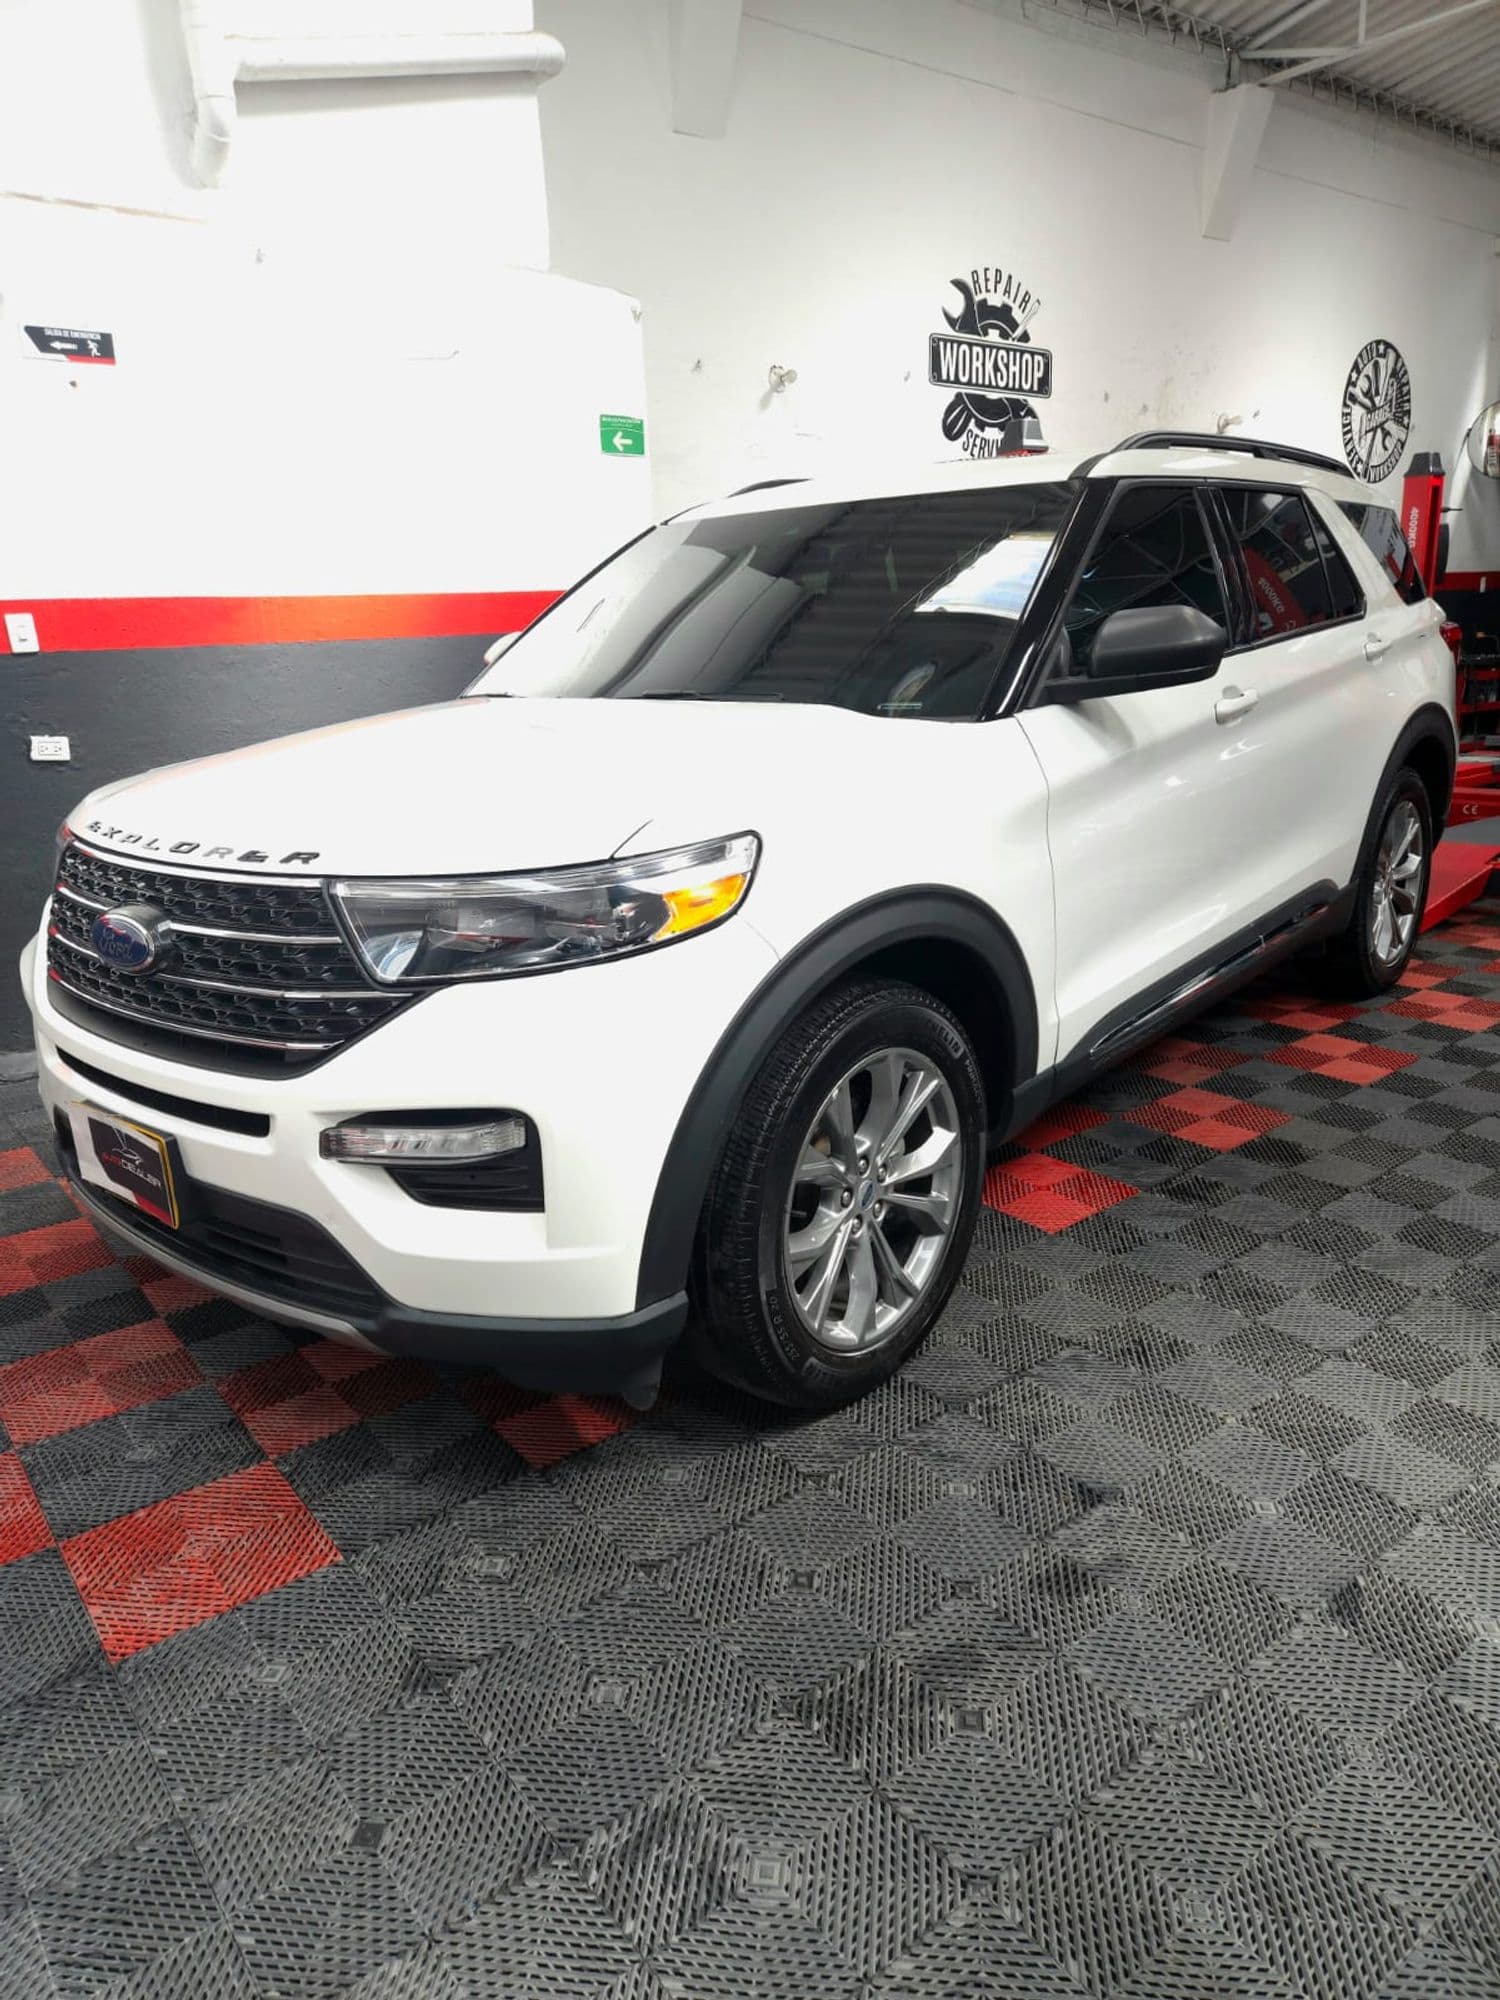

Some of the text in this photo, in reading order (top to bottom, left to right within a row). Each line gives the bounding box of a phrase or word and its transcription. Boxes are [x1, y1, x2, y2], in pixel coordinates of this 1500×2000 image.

[971, 267, 1031, 314] REPAIR
[939, 341, 1044, 392] WORKSHOP
[1462, 803, 1479, 816] CE
[86, 820, 321, 865] EXPLORER
